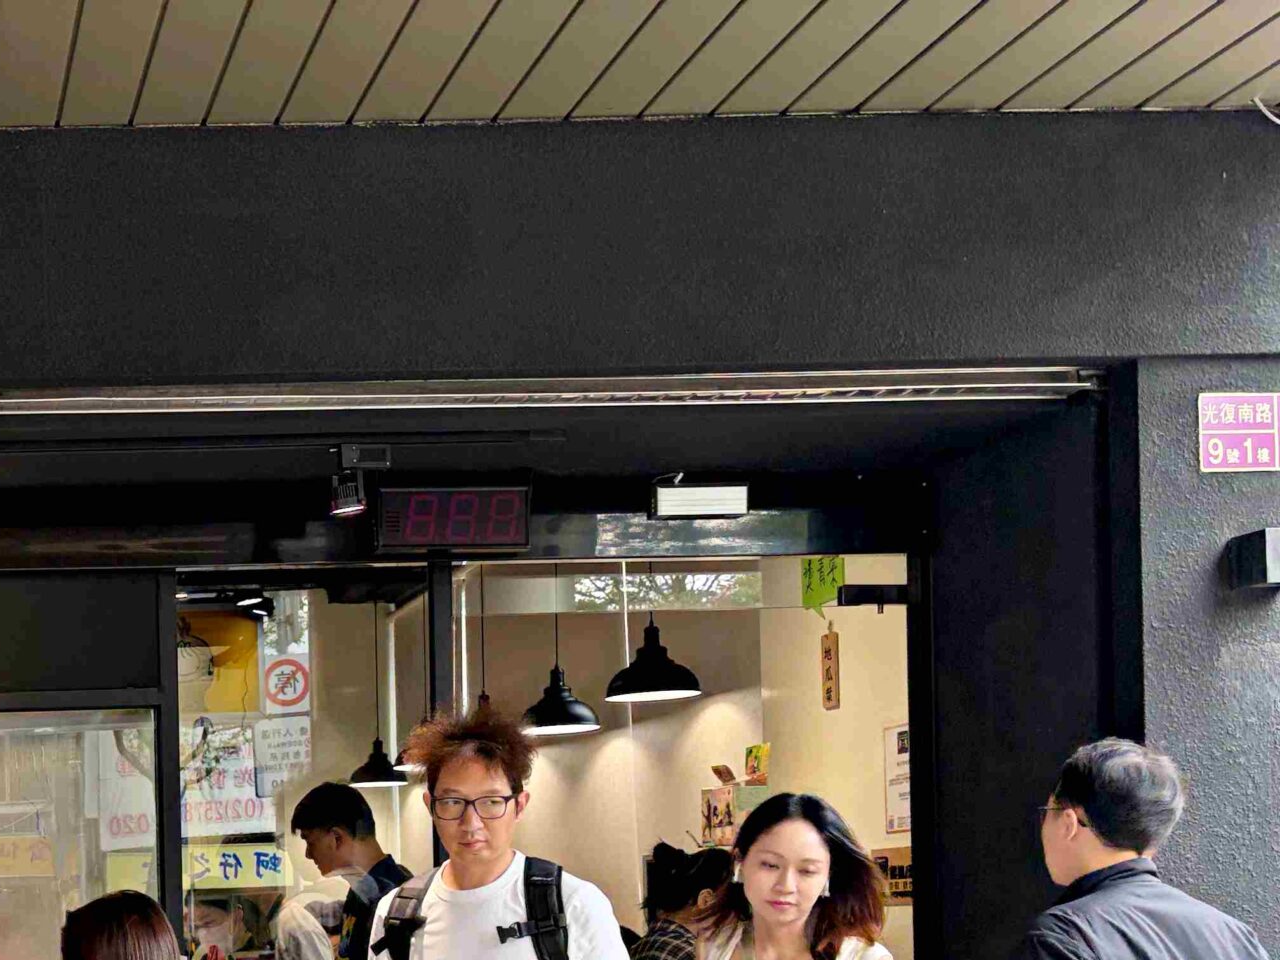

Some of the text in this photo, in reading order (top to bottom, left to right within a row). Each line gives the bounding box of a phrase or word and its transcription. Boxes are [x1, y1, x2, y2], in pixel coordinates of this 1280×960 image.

[1202, 402, 1272, 425] 光復南路
[1207, 437, 1270, 465] 9號1樓
